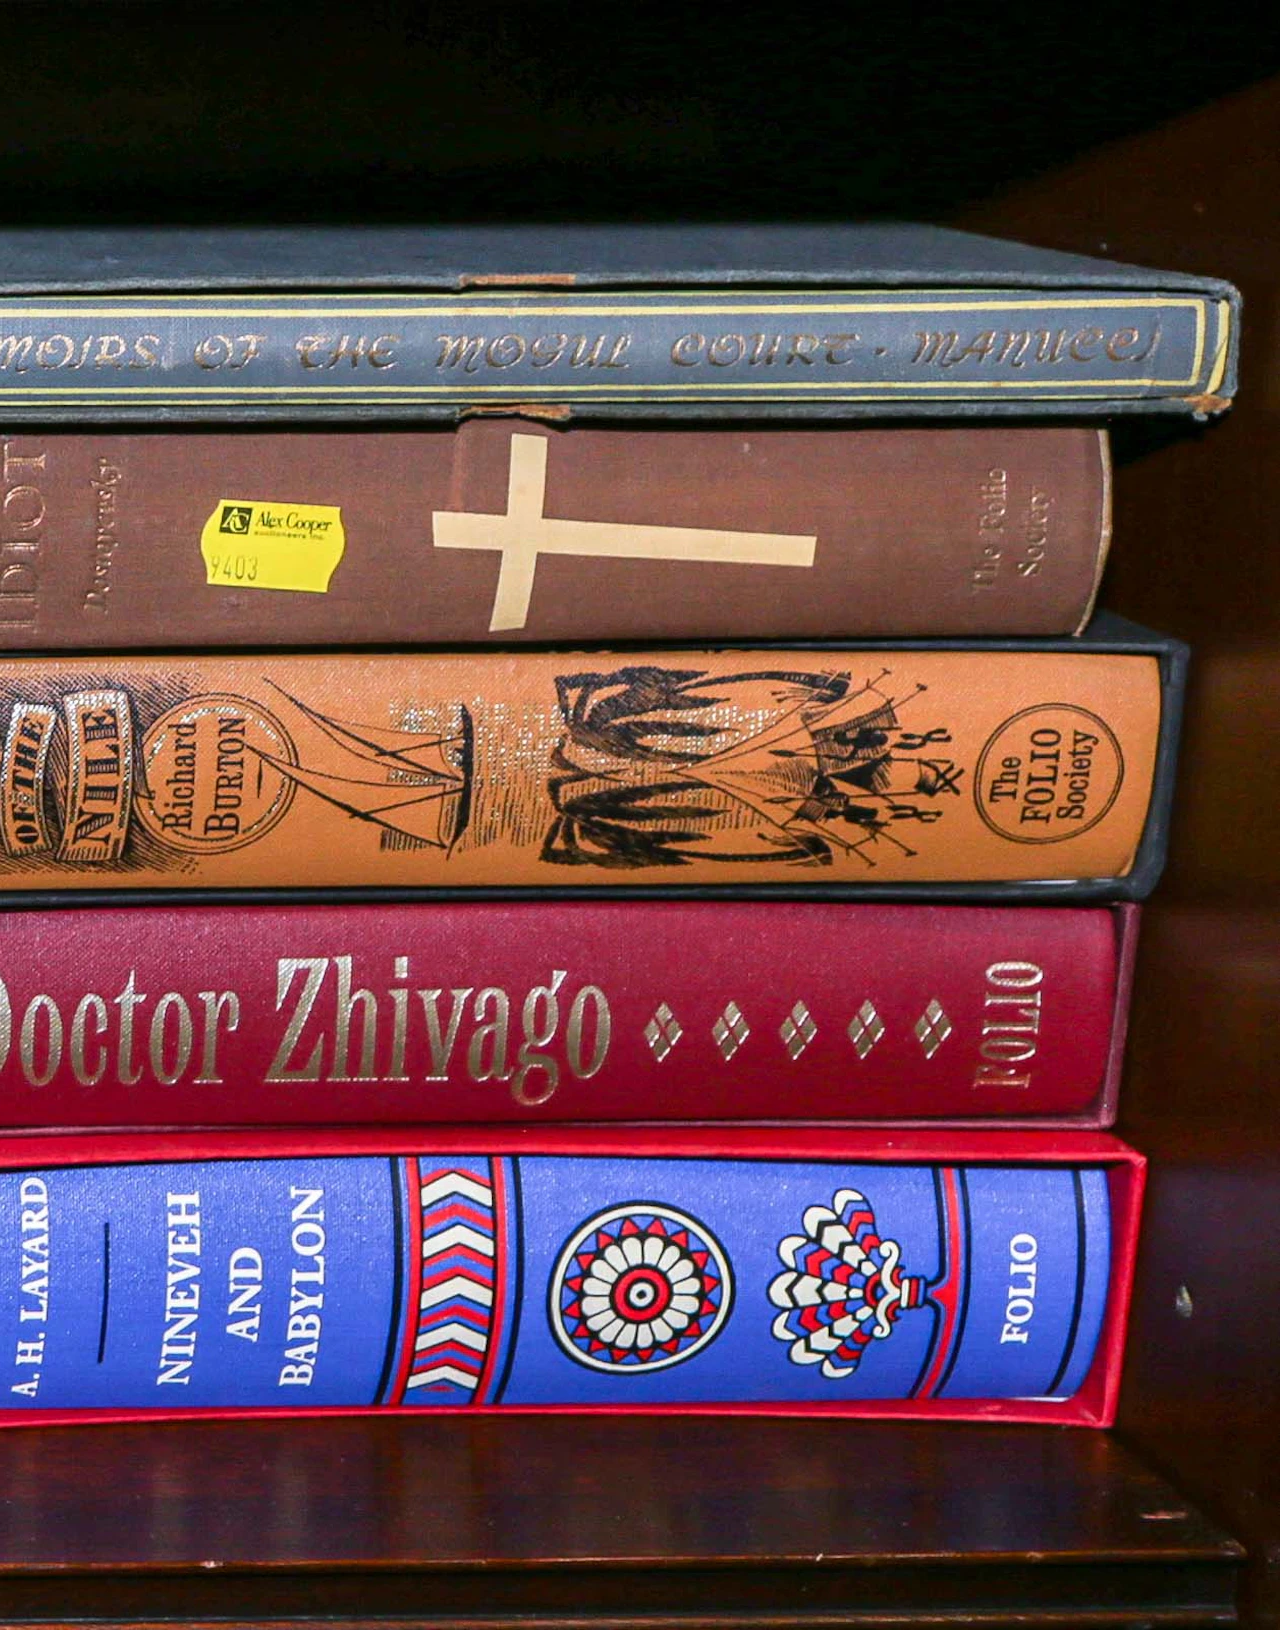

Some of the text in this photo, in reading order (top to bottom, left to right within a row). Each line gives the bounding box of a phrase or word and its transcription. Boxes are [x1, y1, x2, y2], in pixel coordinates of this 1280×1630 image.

[194, 333, 267, 371] OF
[295, 332, 401, 371] THE
[437, 330, 633, 373] MOGUL
[669, 330, 863, 368] COURT
[911, 324, 1161, 369] MANUCCI
[211, 555, 258, 580] 9403
[256, 511, 332, 534] Alex Cooper
[972, 467, 1008, 594] The Folio
[12, 716, 45, 847] OF THE
[72, 706, 118, 847] NILE
[161, 719, 198, 831] Richard
[202, 716, 248, 837] BURTON
[990, 756, 1021, 803] The
[1020, 727, 1062, 825] FOLIO
[1056, 728, 1100, 821] Society
[264, 955, 612, 1106] Zhivago
[972, 960, 1043, 1090] FOLIO
[11, 1176, 48, 1398] A. H. LAYARD
[157, 1190, 200, 1386] NINEVEH
[227, 1246, 262, 1343] AND
[278, 1185, 325, 1387] BABYLON
[1001, 1233, 1038, 1345] FOLIO
